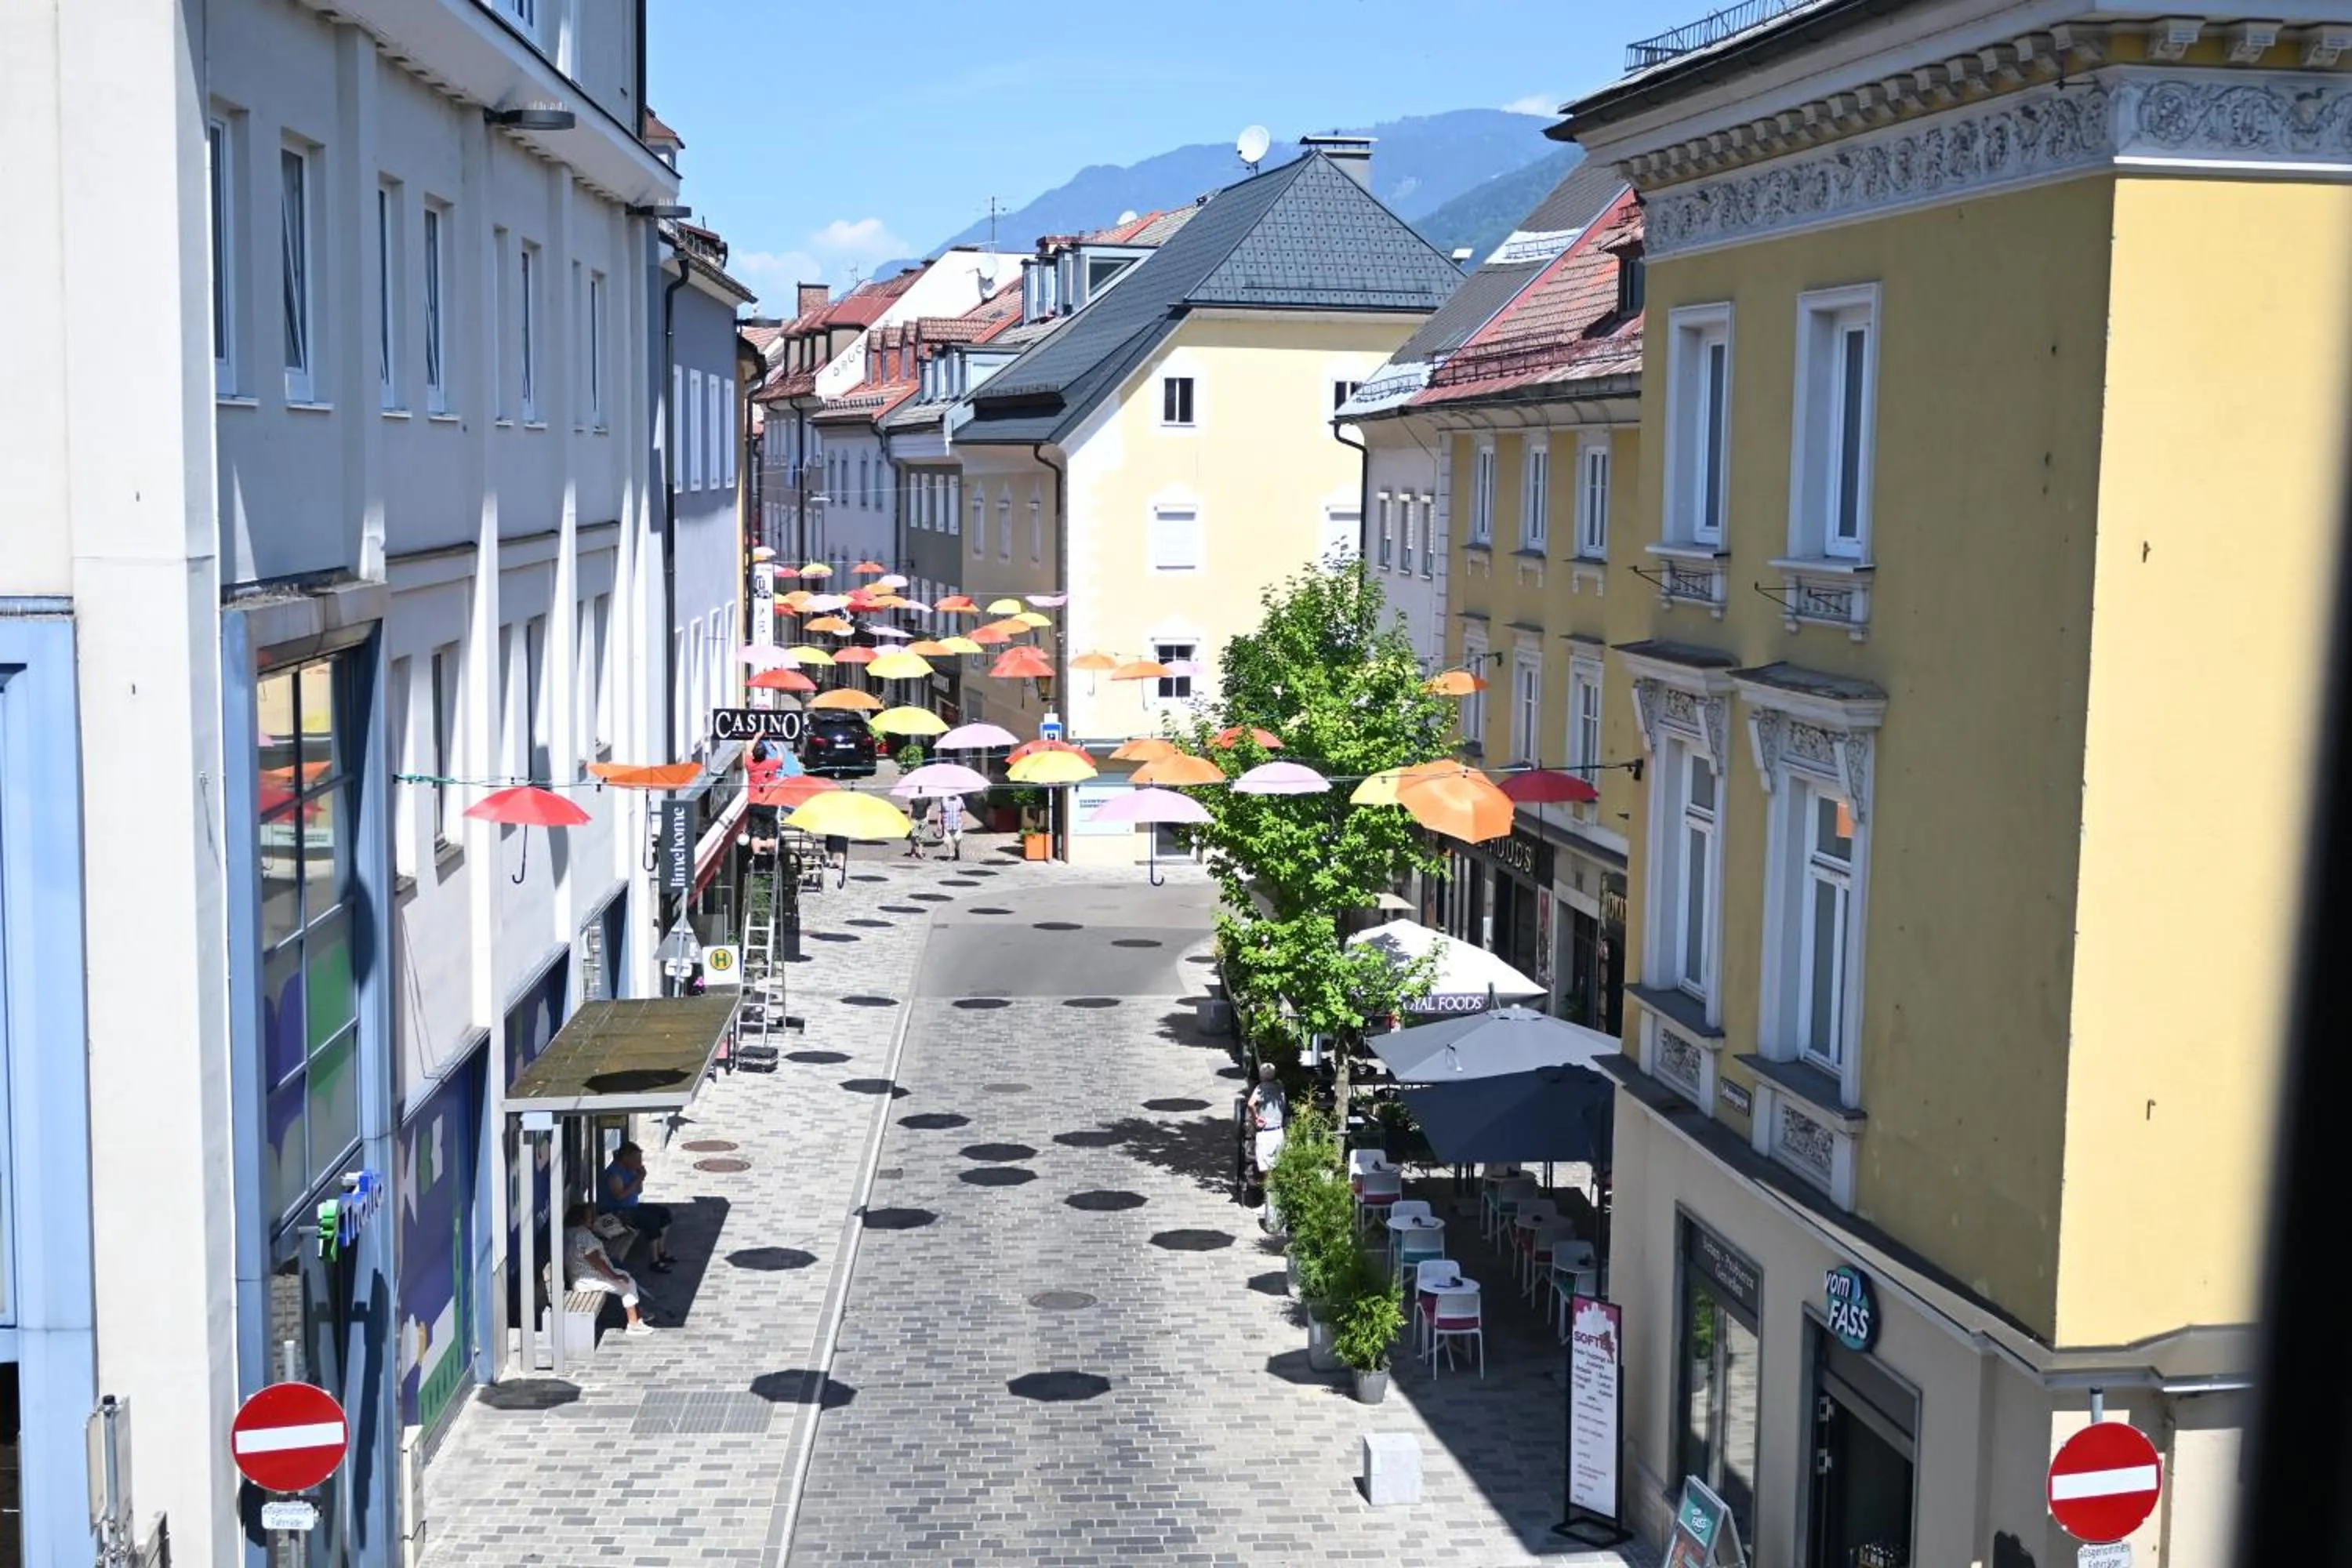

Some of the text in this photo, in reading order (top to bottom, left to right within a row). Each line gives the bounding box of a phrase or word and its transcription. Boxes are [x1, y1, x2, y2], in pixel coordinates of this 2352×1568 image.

[715, 711, 800, 739] CASINO
[670, 806, 686, 887] limehome
[1403, 996, 1482, 1011] OYAL FOODS
[1824, 1270, 1849, 1298] vom
[1828, 1300, 1869, 1340] FASS
